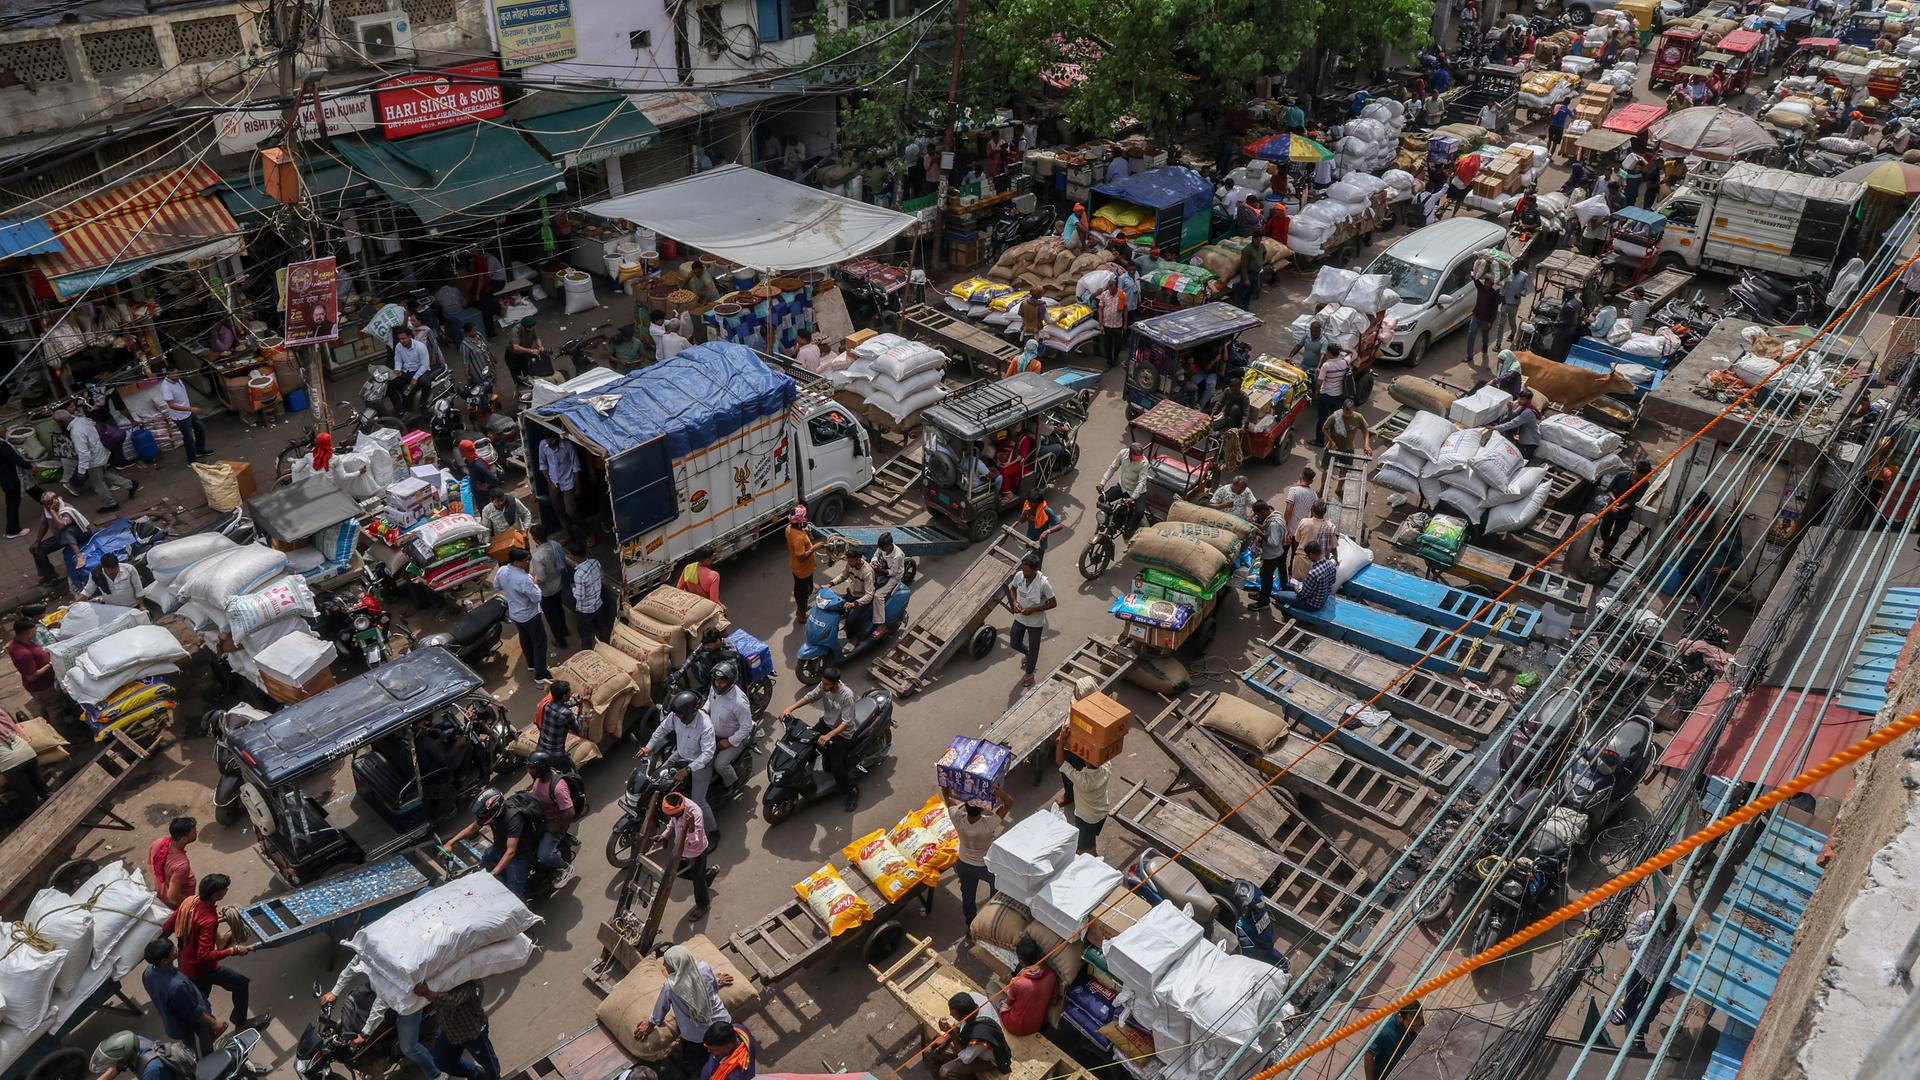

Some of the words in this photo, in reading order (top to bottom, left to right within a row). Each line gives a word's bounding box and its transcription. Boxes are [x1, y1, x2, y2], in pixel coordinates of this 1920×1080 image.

[302, 109, 336, 123] NAVEN
[337, 101, 367, 117] KUMAR
[384, 102, 418, 121] HARI
[419, 93, 457, 113] SINGH
[459, 92, 469, 106] &
[470, 85, 500, 104] SONS
[462, 100, 501, 113] MERCHANTS
[243, 119, 268, 134] RISHI
